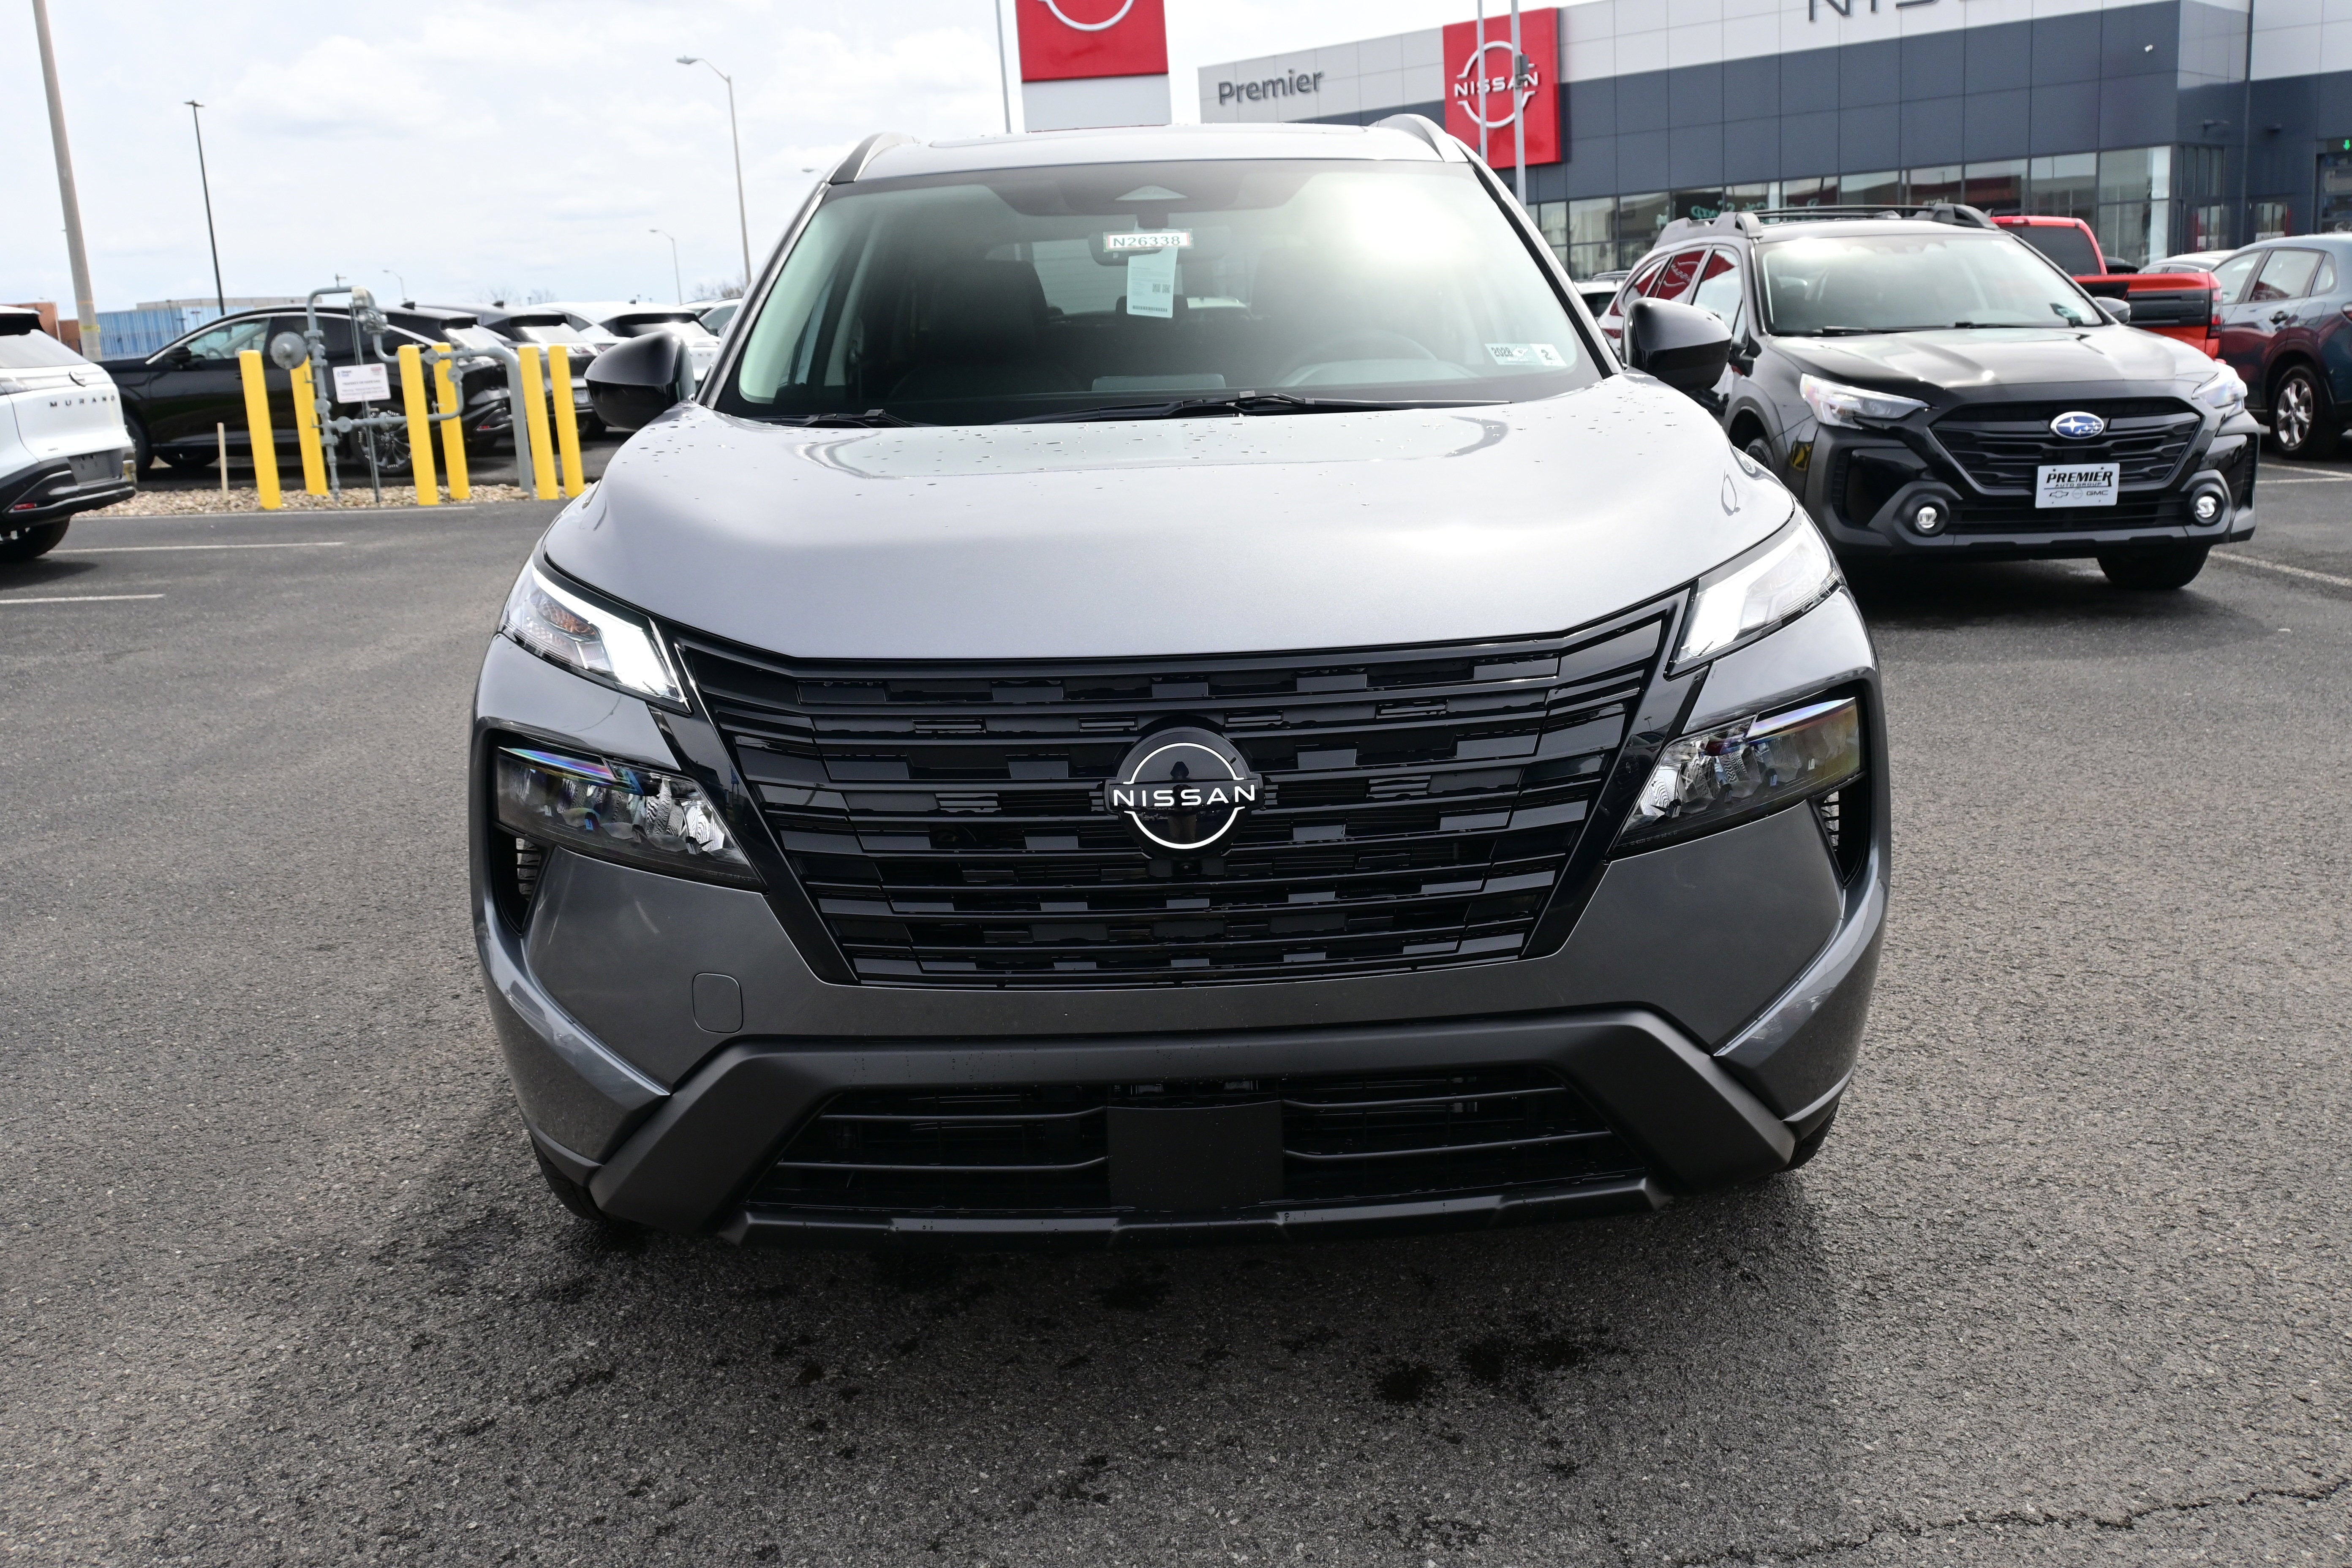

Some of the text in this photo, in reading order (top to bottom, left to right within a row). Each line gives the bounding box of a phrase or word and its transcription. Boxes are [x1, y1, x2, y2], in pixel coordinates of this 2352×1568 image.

[1218, 68, 1324, 105] Premier
[1113, 236, 1181, 247] N26338
[1491, 347, 1514, 357] 2028
[1541, 349, 1553, 360] 2
[49, 395, 115, 407] MURANO
[2046, 471, 2113, 487] PREMIER
[1113, 784, 1255, 807] NISSAN
